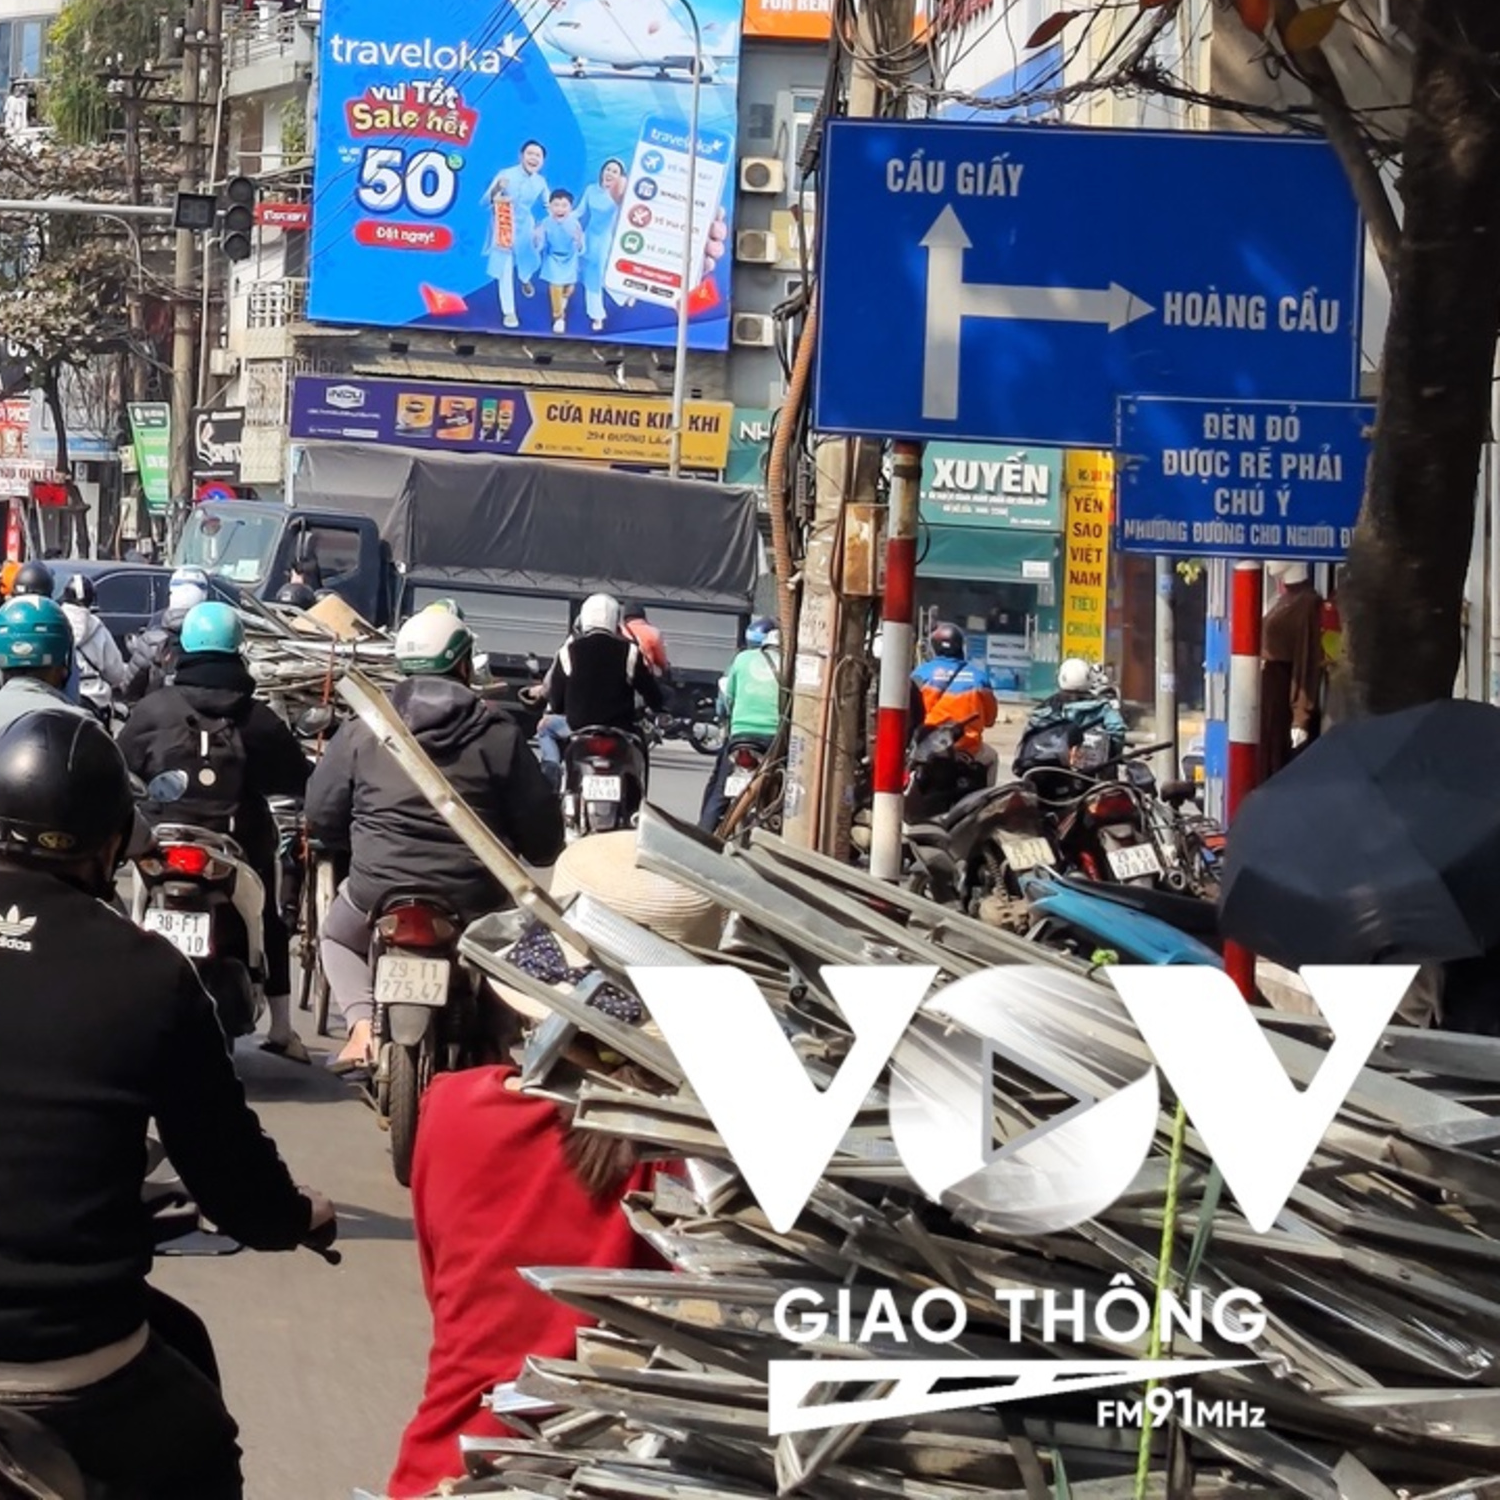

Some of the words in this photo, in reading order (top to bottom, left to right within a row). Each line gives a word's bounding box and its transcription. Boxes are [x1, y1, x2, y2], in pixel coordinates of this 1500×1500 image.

[330, 34, 501, 74] traveloka
[353, 103, 419, 130] Sale
[956, 153, 1025, 197] GIẤY
[1163, 285, 1267, 331] HOÀNG
[546, 401, 583, 424] CỬA
[589, 405, 640, 428] HÀNG
[1265, 404, 1300, 442] ĐỎ
[932, 451, 1049, 494] XUYẾN
[1163, 449, 1230, 484] ĐƯỢC
[1281, 444, 1342, 481] PHẢI
[1214, 484, 1264, 517] CHÚ
[1277, 484, 1291, 517] Ý
[1251, 525, 1280, 546] CHO
[1069, 570, 1100, 586] NAM
